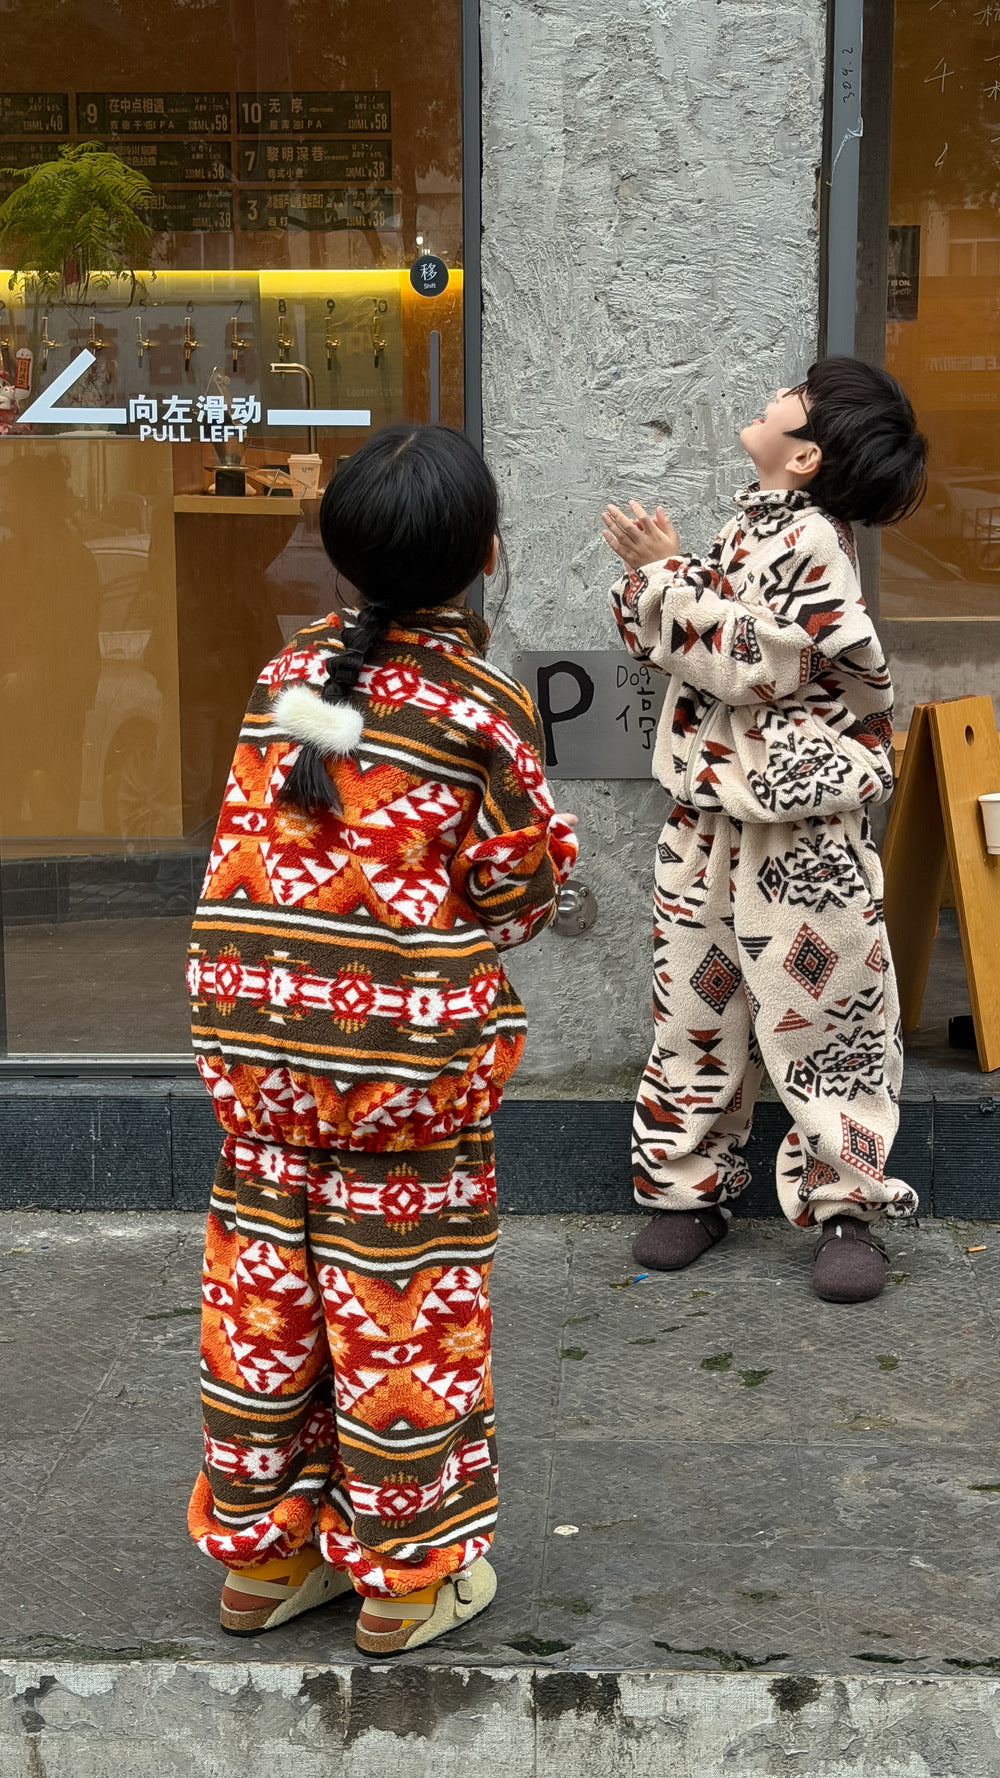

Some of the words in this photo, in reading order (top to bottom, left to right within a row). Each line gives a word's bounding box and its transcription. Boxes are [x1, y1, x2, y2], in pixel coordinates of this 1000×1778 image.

[87, 103, 97, 124] 9
[241, 103, 262, 124] 10
[244, 151, 256, 172] 7
[247, 199, 258, 221] 3
[419, 262, 438, 281] 移
[423, 282, 437, 290] Shift
[139, 299, 147, 313] 5
[186, 300, 194, 313] 6
[234, 300, 243, 313] 7
[278, 298, 287, 313] 8
[326, 298, 335, 314] 9
[373, 298, 388, 314] 10
[129, 394, 262, 424] 向左滑动
[139, 424, 192, 442] PULL
[199, 425, 248, 443] LEFT
[537, 661, 595, 767] P
